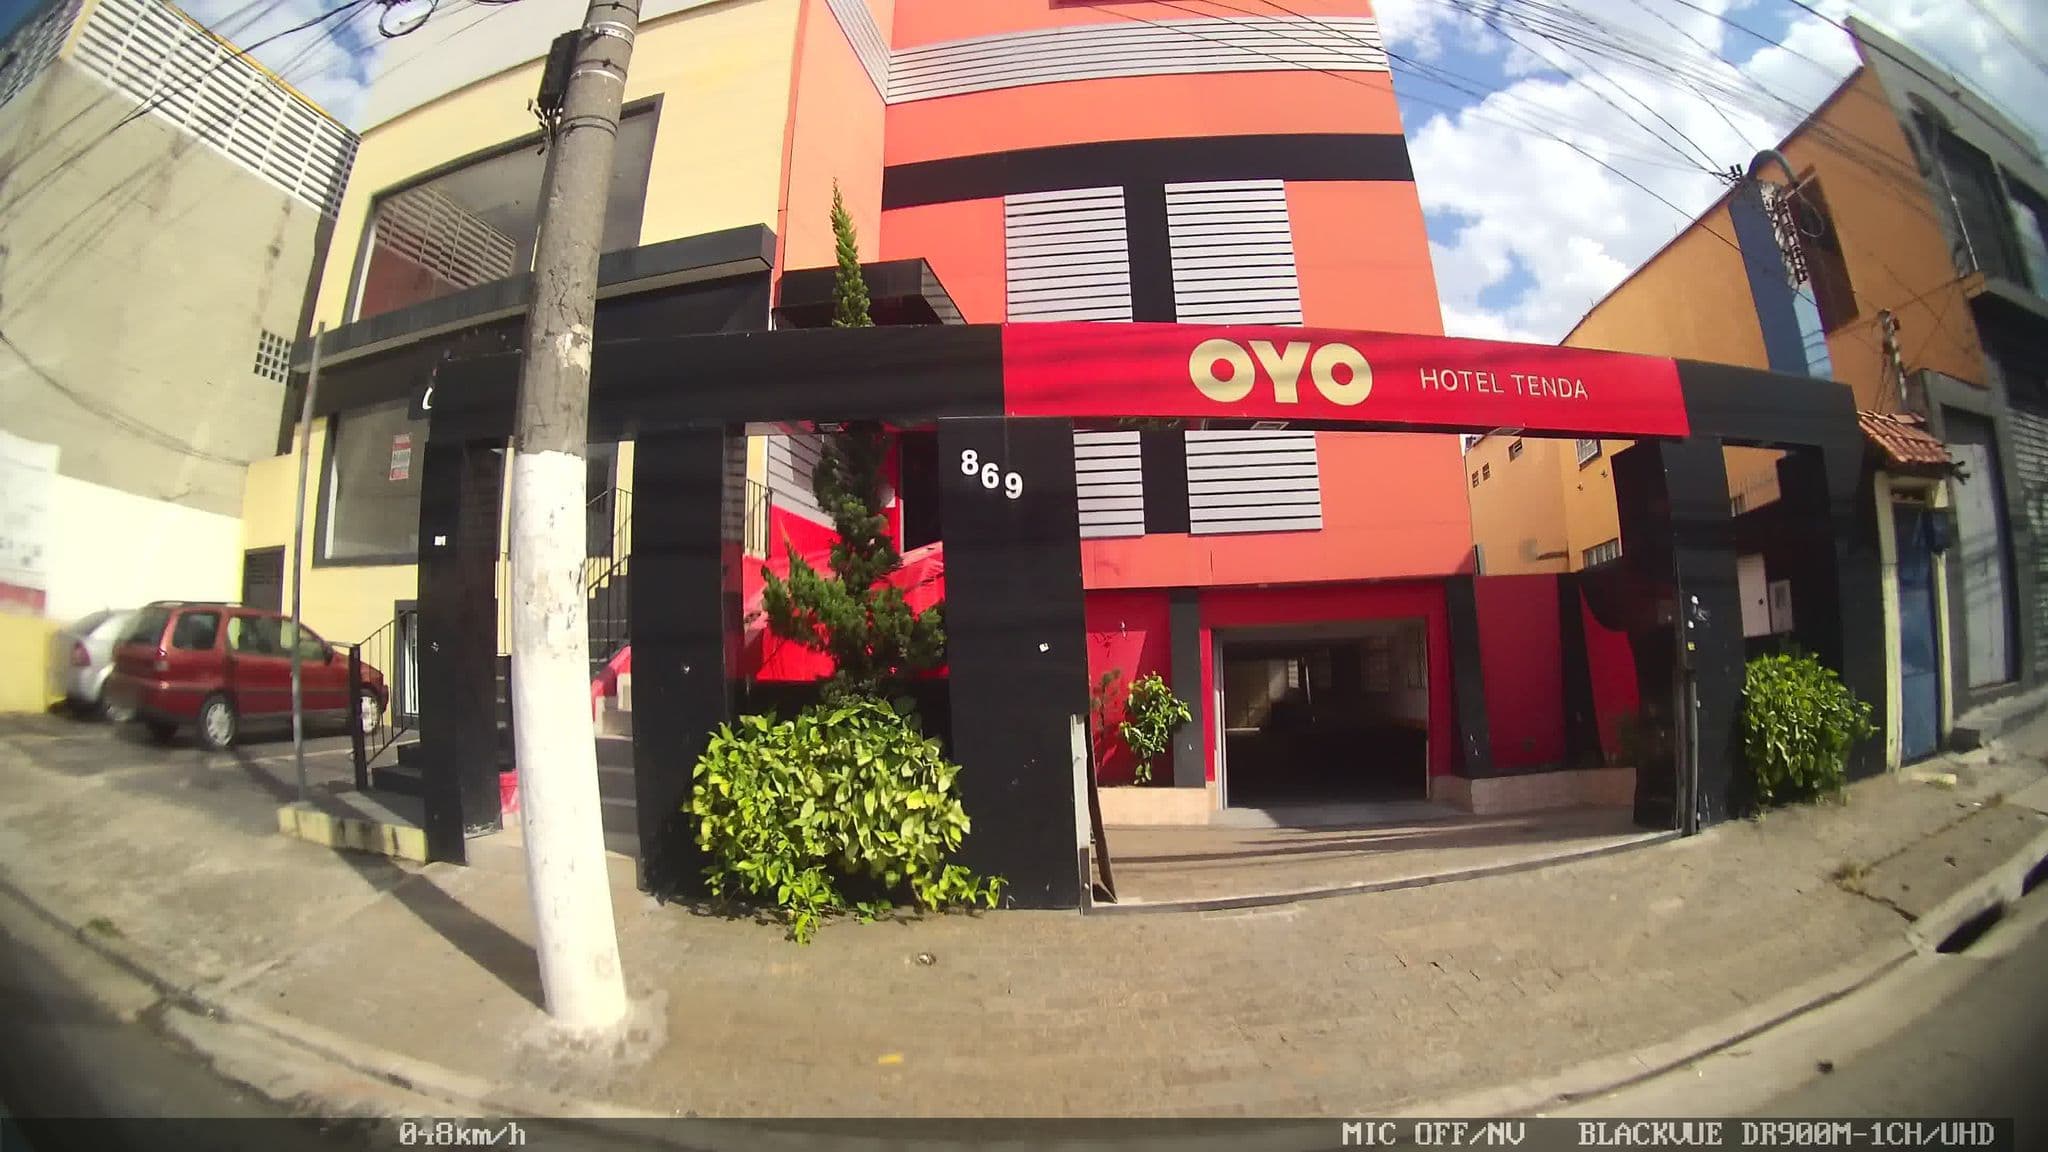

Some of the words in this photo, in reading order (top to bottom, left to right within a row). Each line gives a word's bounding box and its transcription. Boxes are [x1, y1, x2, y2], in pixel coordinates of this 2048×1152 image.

[1188, 338, 1373, 406] OYO
[1419, 367, 1505, 394] HOTEL
[1510, 373, 1589, 400] TENDA
[960, 449, 1024, 500] 869
